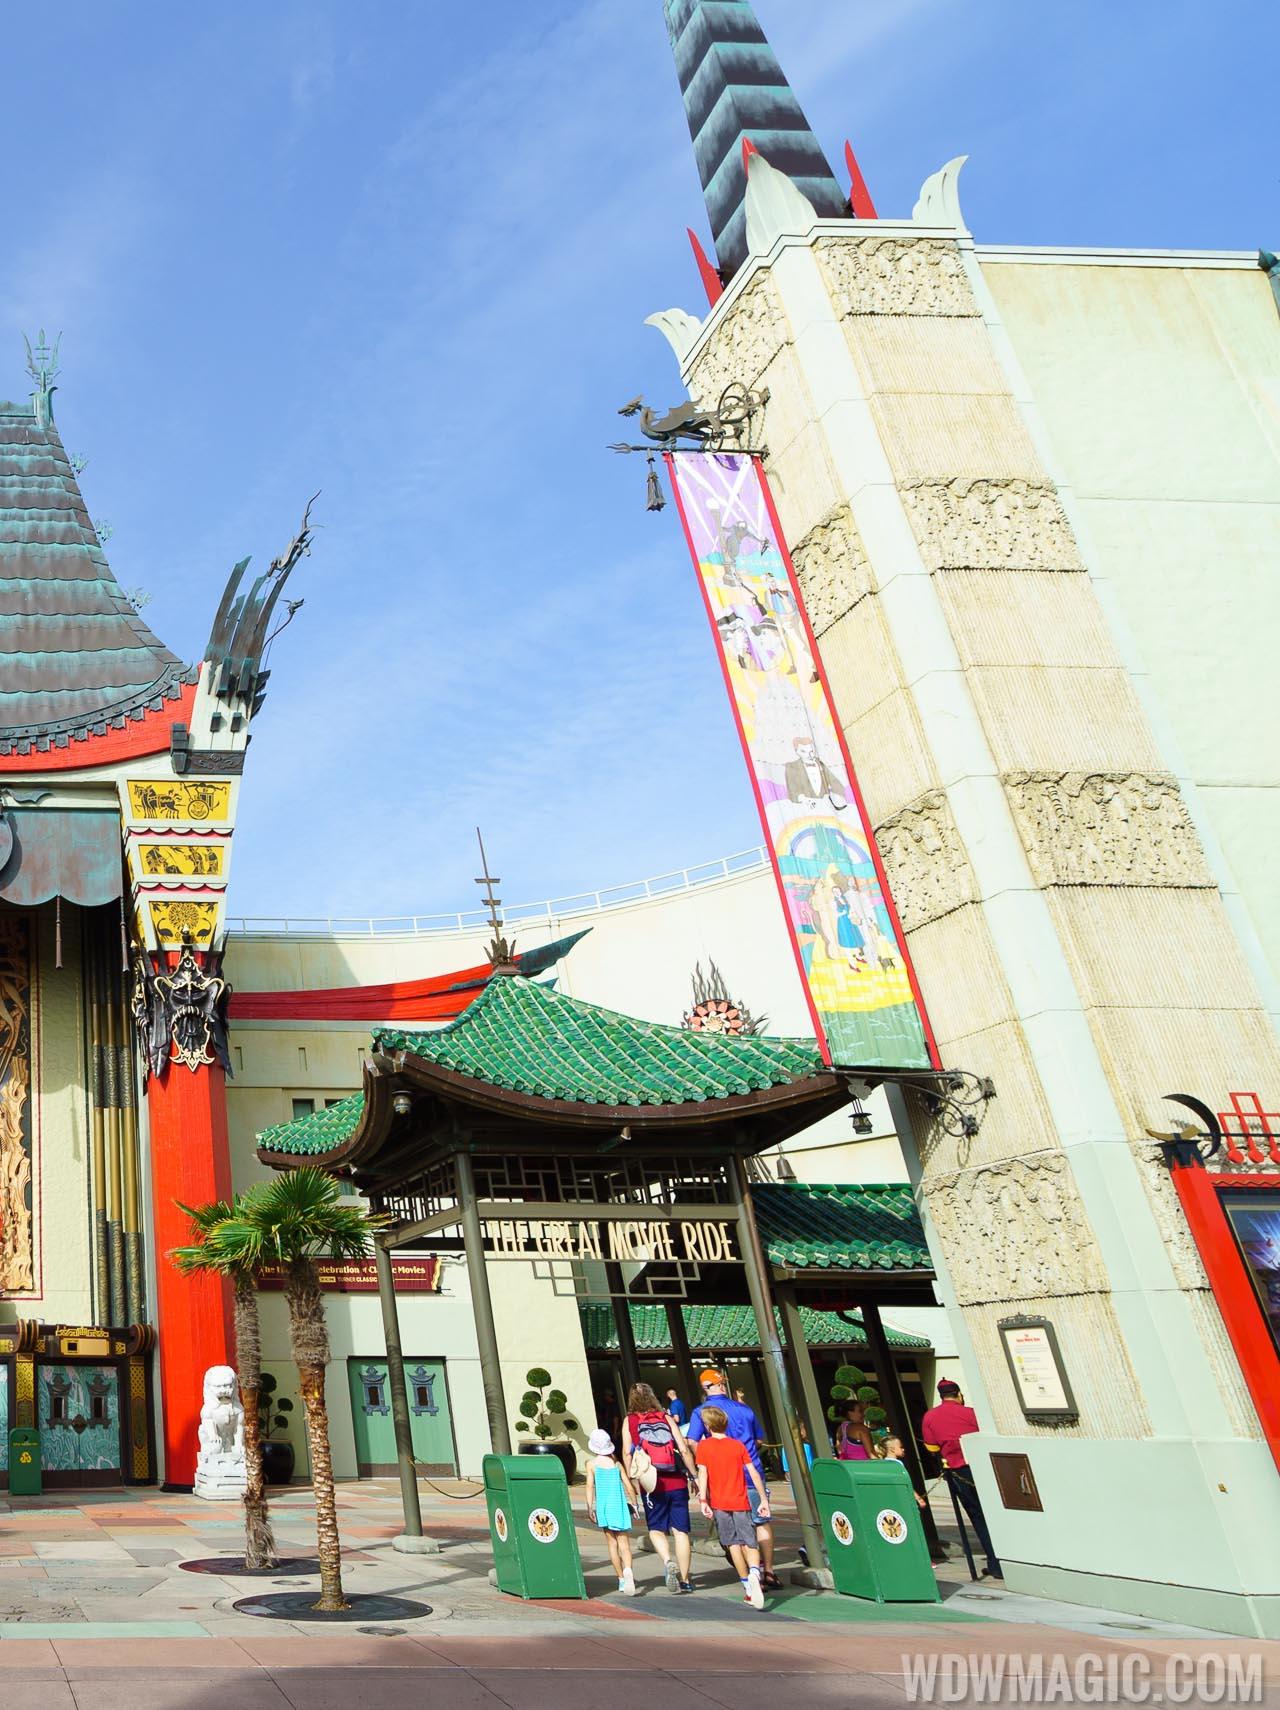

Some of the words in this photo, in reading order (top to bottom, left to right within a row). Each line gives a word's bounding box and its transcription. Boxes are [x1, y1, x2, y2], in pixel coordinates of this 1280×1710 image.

[488, 1220, 528, 1259] THE
[535, 1220, 603, 1260] GREAT
[608, 1221, 678, 1260] MOVIE
[681, 1221, 737, 1261] RIDE
[319, 1265, 360, 1274] elebration
[398, 1265, 426, 1274] Movies
